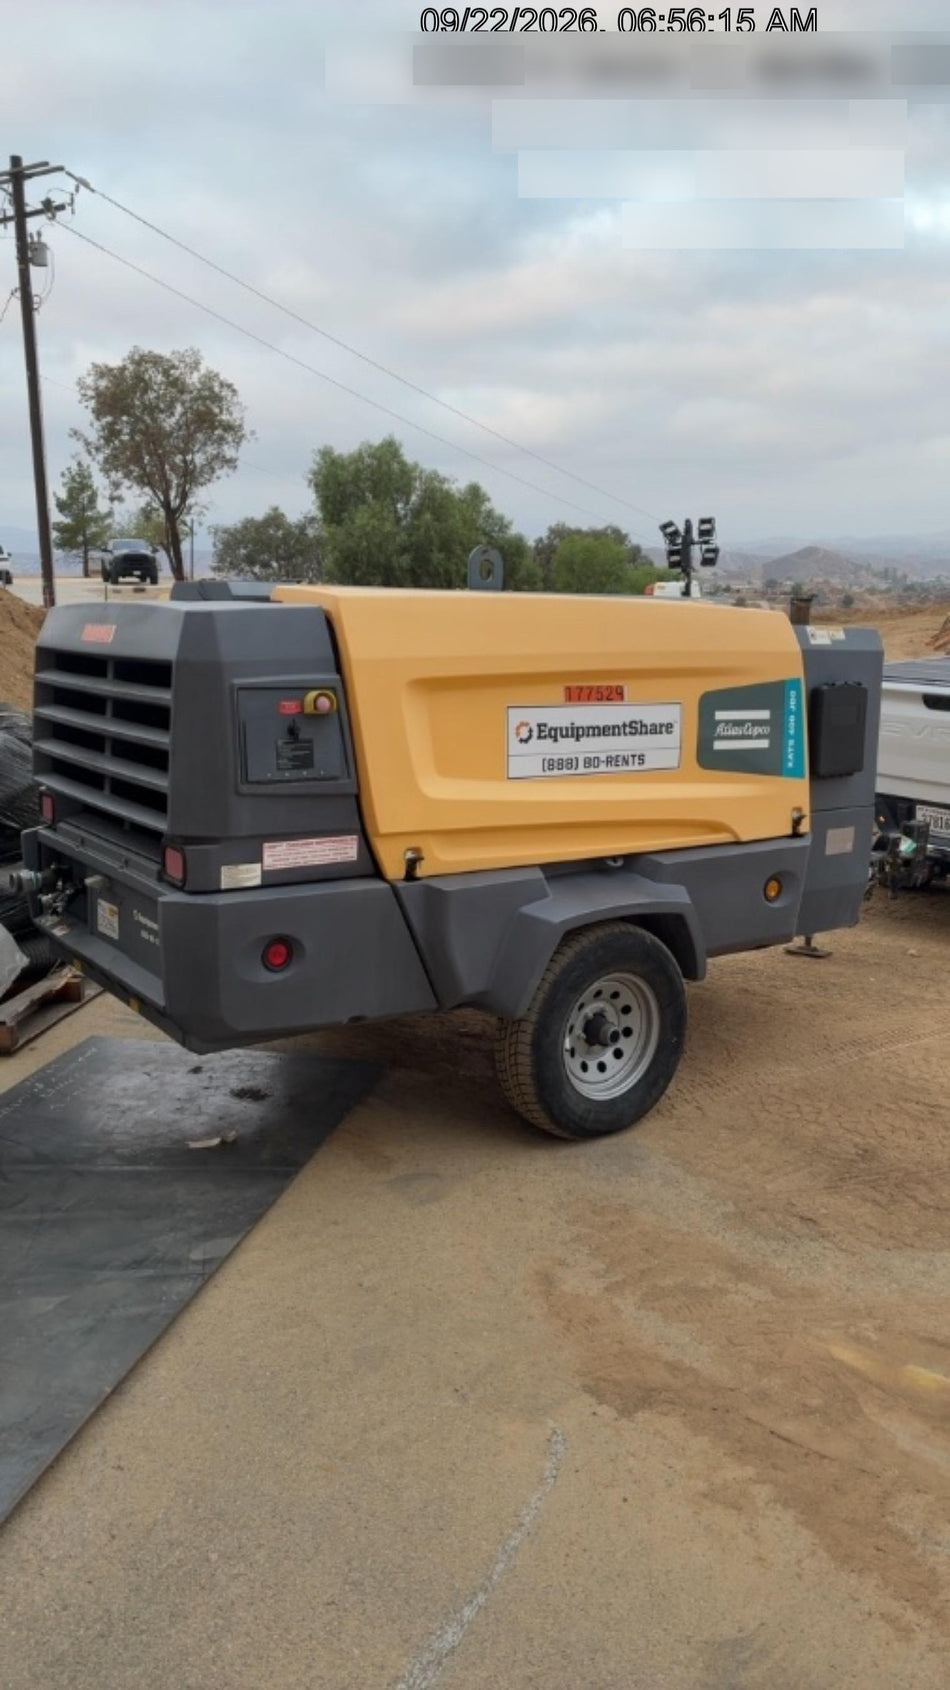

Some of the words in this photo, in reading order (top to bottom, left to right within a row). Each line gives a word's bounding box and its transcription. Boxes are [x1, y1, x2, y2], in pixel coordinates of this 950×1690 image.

[565, 685, 624, 701] 177529
[536, 719, 674, 743] EquipmentShare
[542, 757, 579, 772] (888)
[583, 753, 645, 769] 80-RENTS
